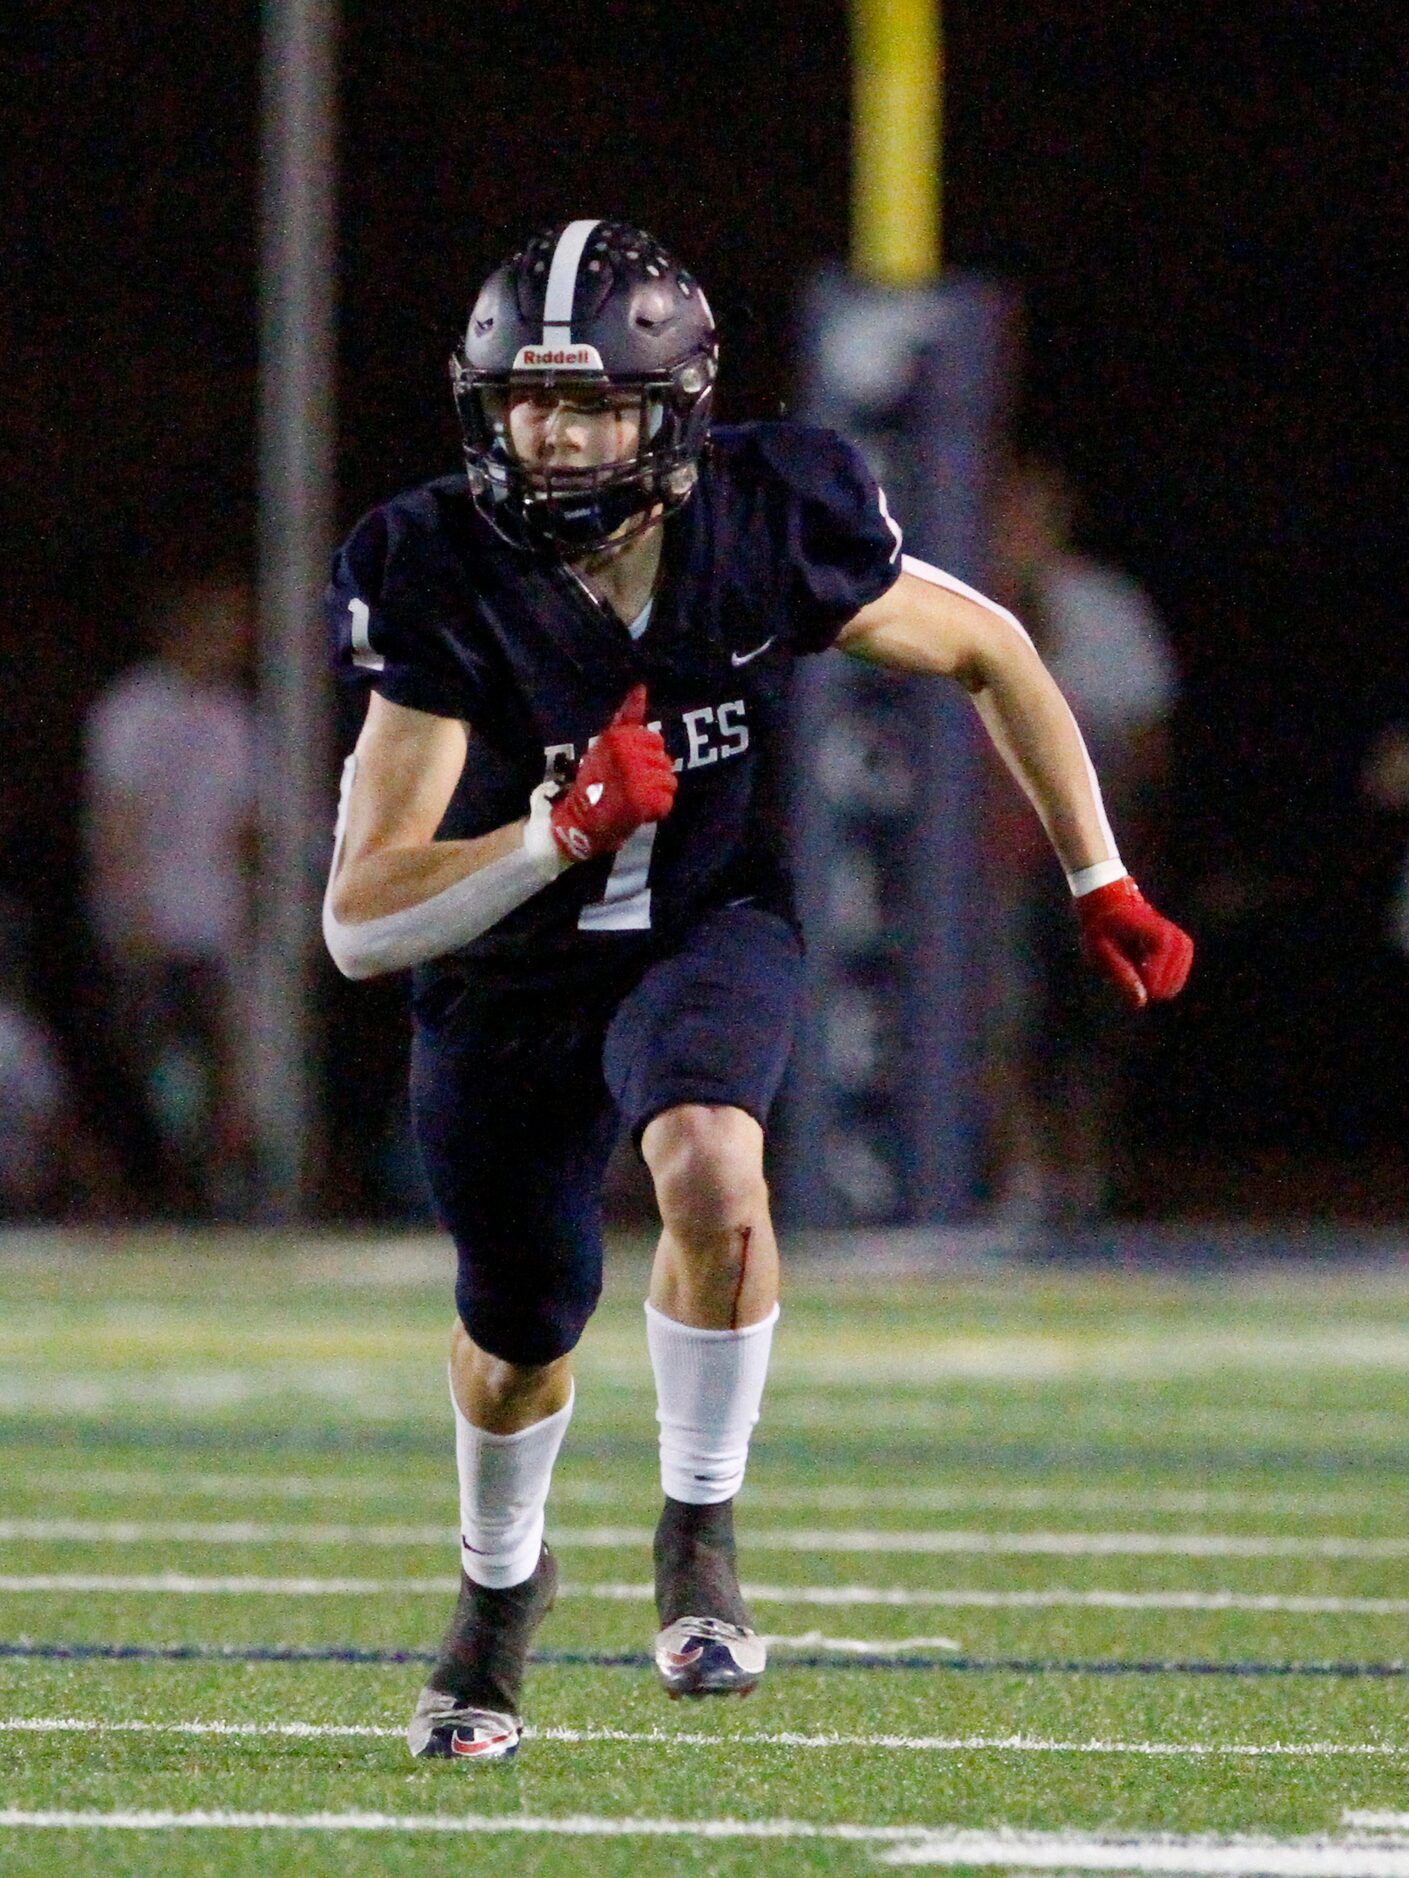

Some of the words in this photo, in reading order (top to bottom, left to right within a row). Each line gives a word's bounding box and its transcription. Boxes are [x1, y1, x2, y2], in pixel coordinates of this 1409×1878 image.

[524, 349, 590, 365] Riddell
[347, 597, 385, 672] 1
[577, 821, 652, 931] 1
